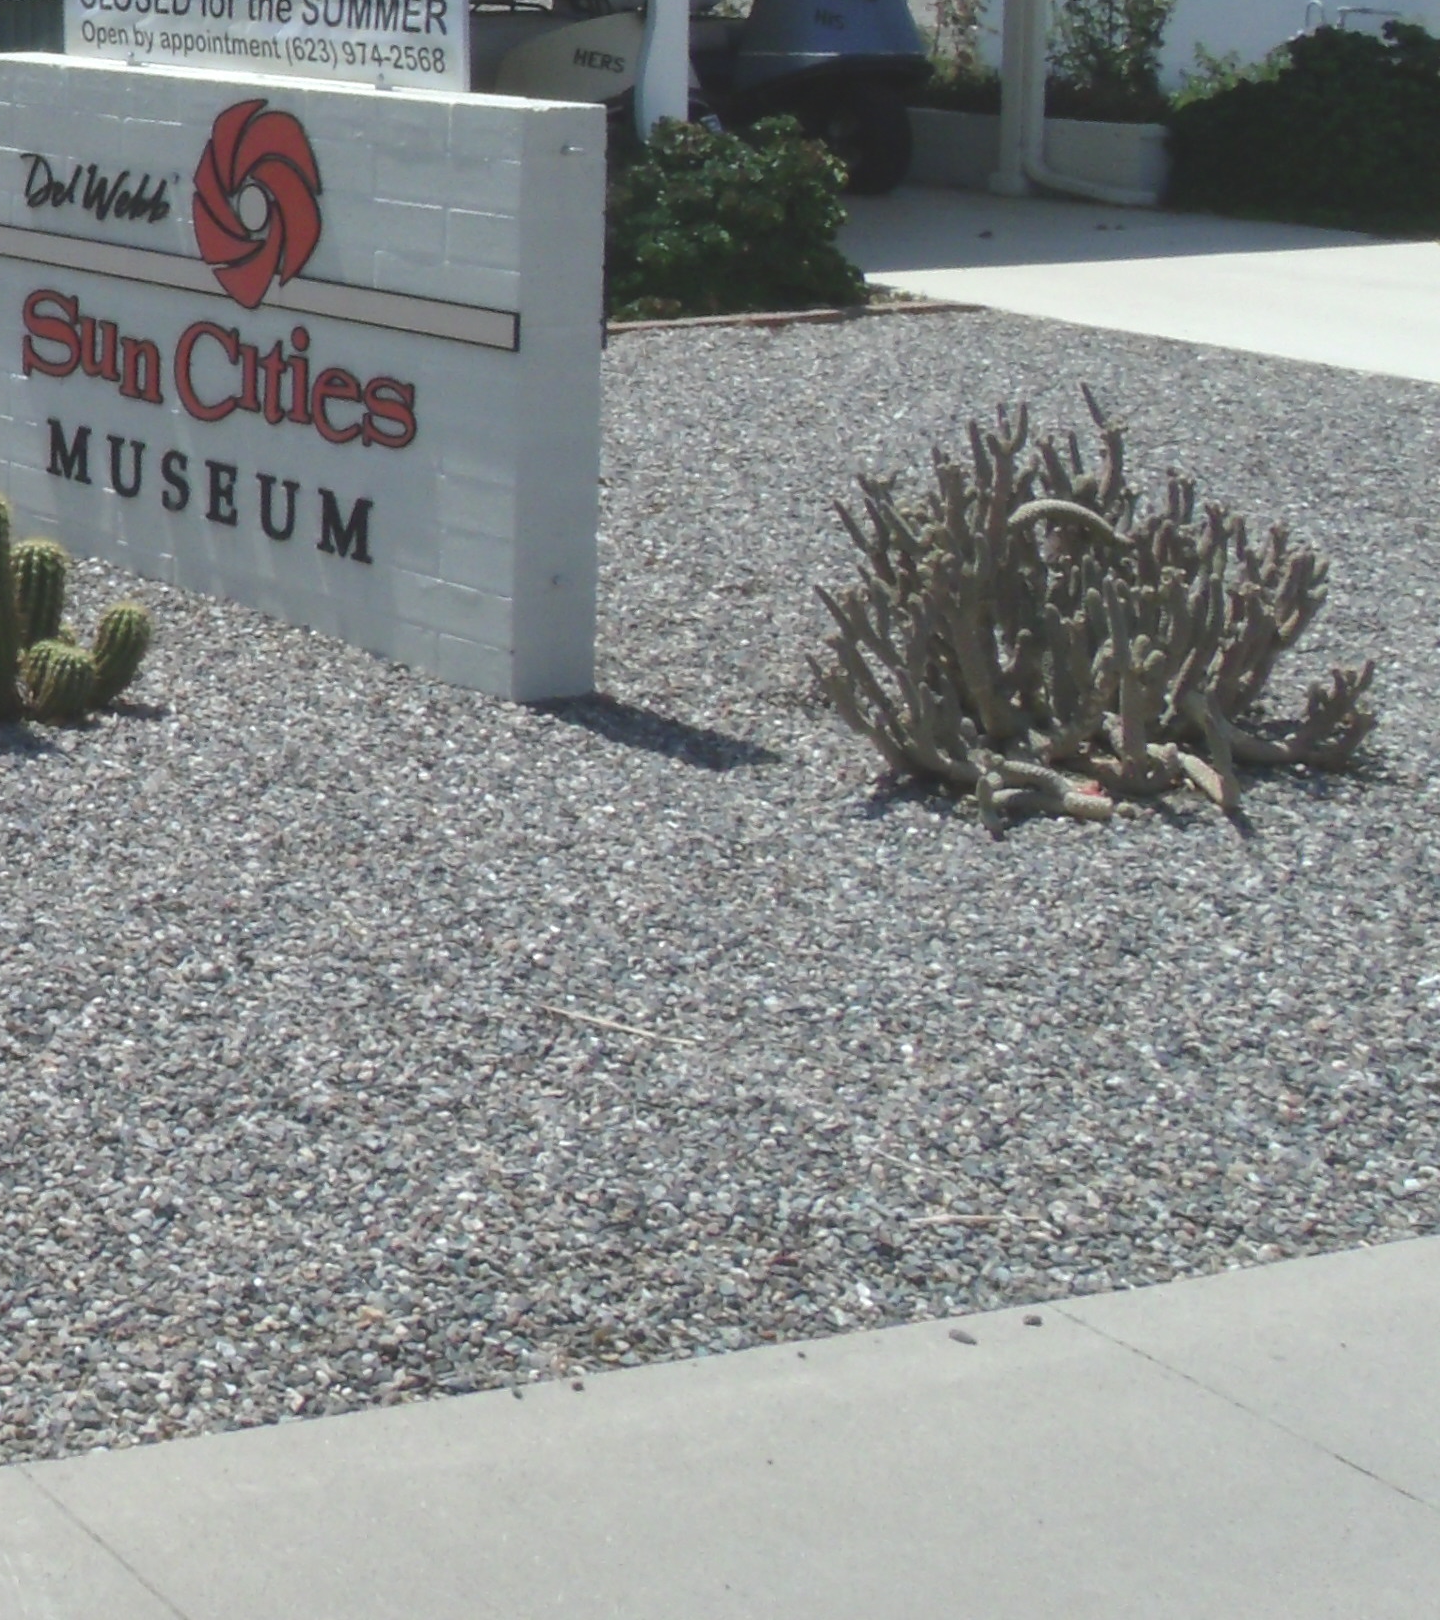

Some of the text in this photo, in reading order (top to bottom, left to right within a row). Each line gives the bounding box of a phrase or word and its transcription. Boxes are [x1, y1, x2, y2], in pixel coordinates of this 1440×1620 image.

[81, 20, 446, 75] Open by appointment (623) 974-2568
[573, 47, 625, 74] HERS
[20, 152, 171, 224] Del Webb
[22, 288, 418, 449] Sun Cities
[46, 417, 375, 565] MUSEUM
